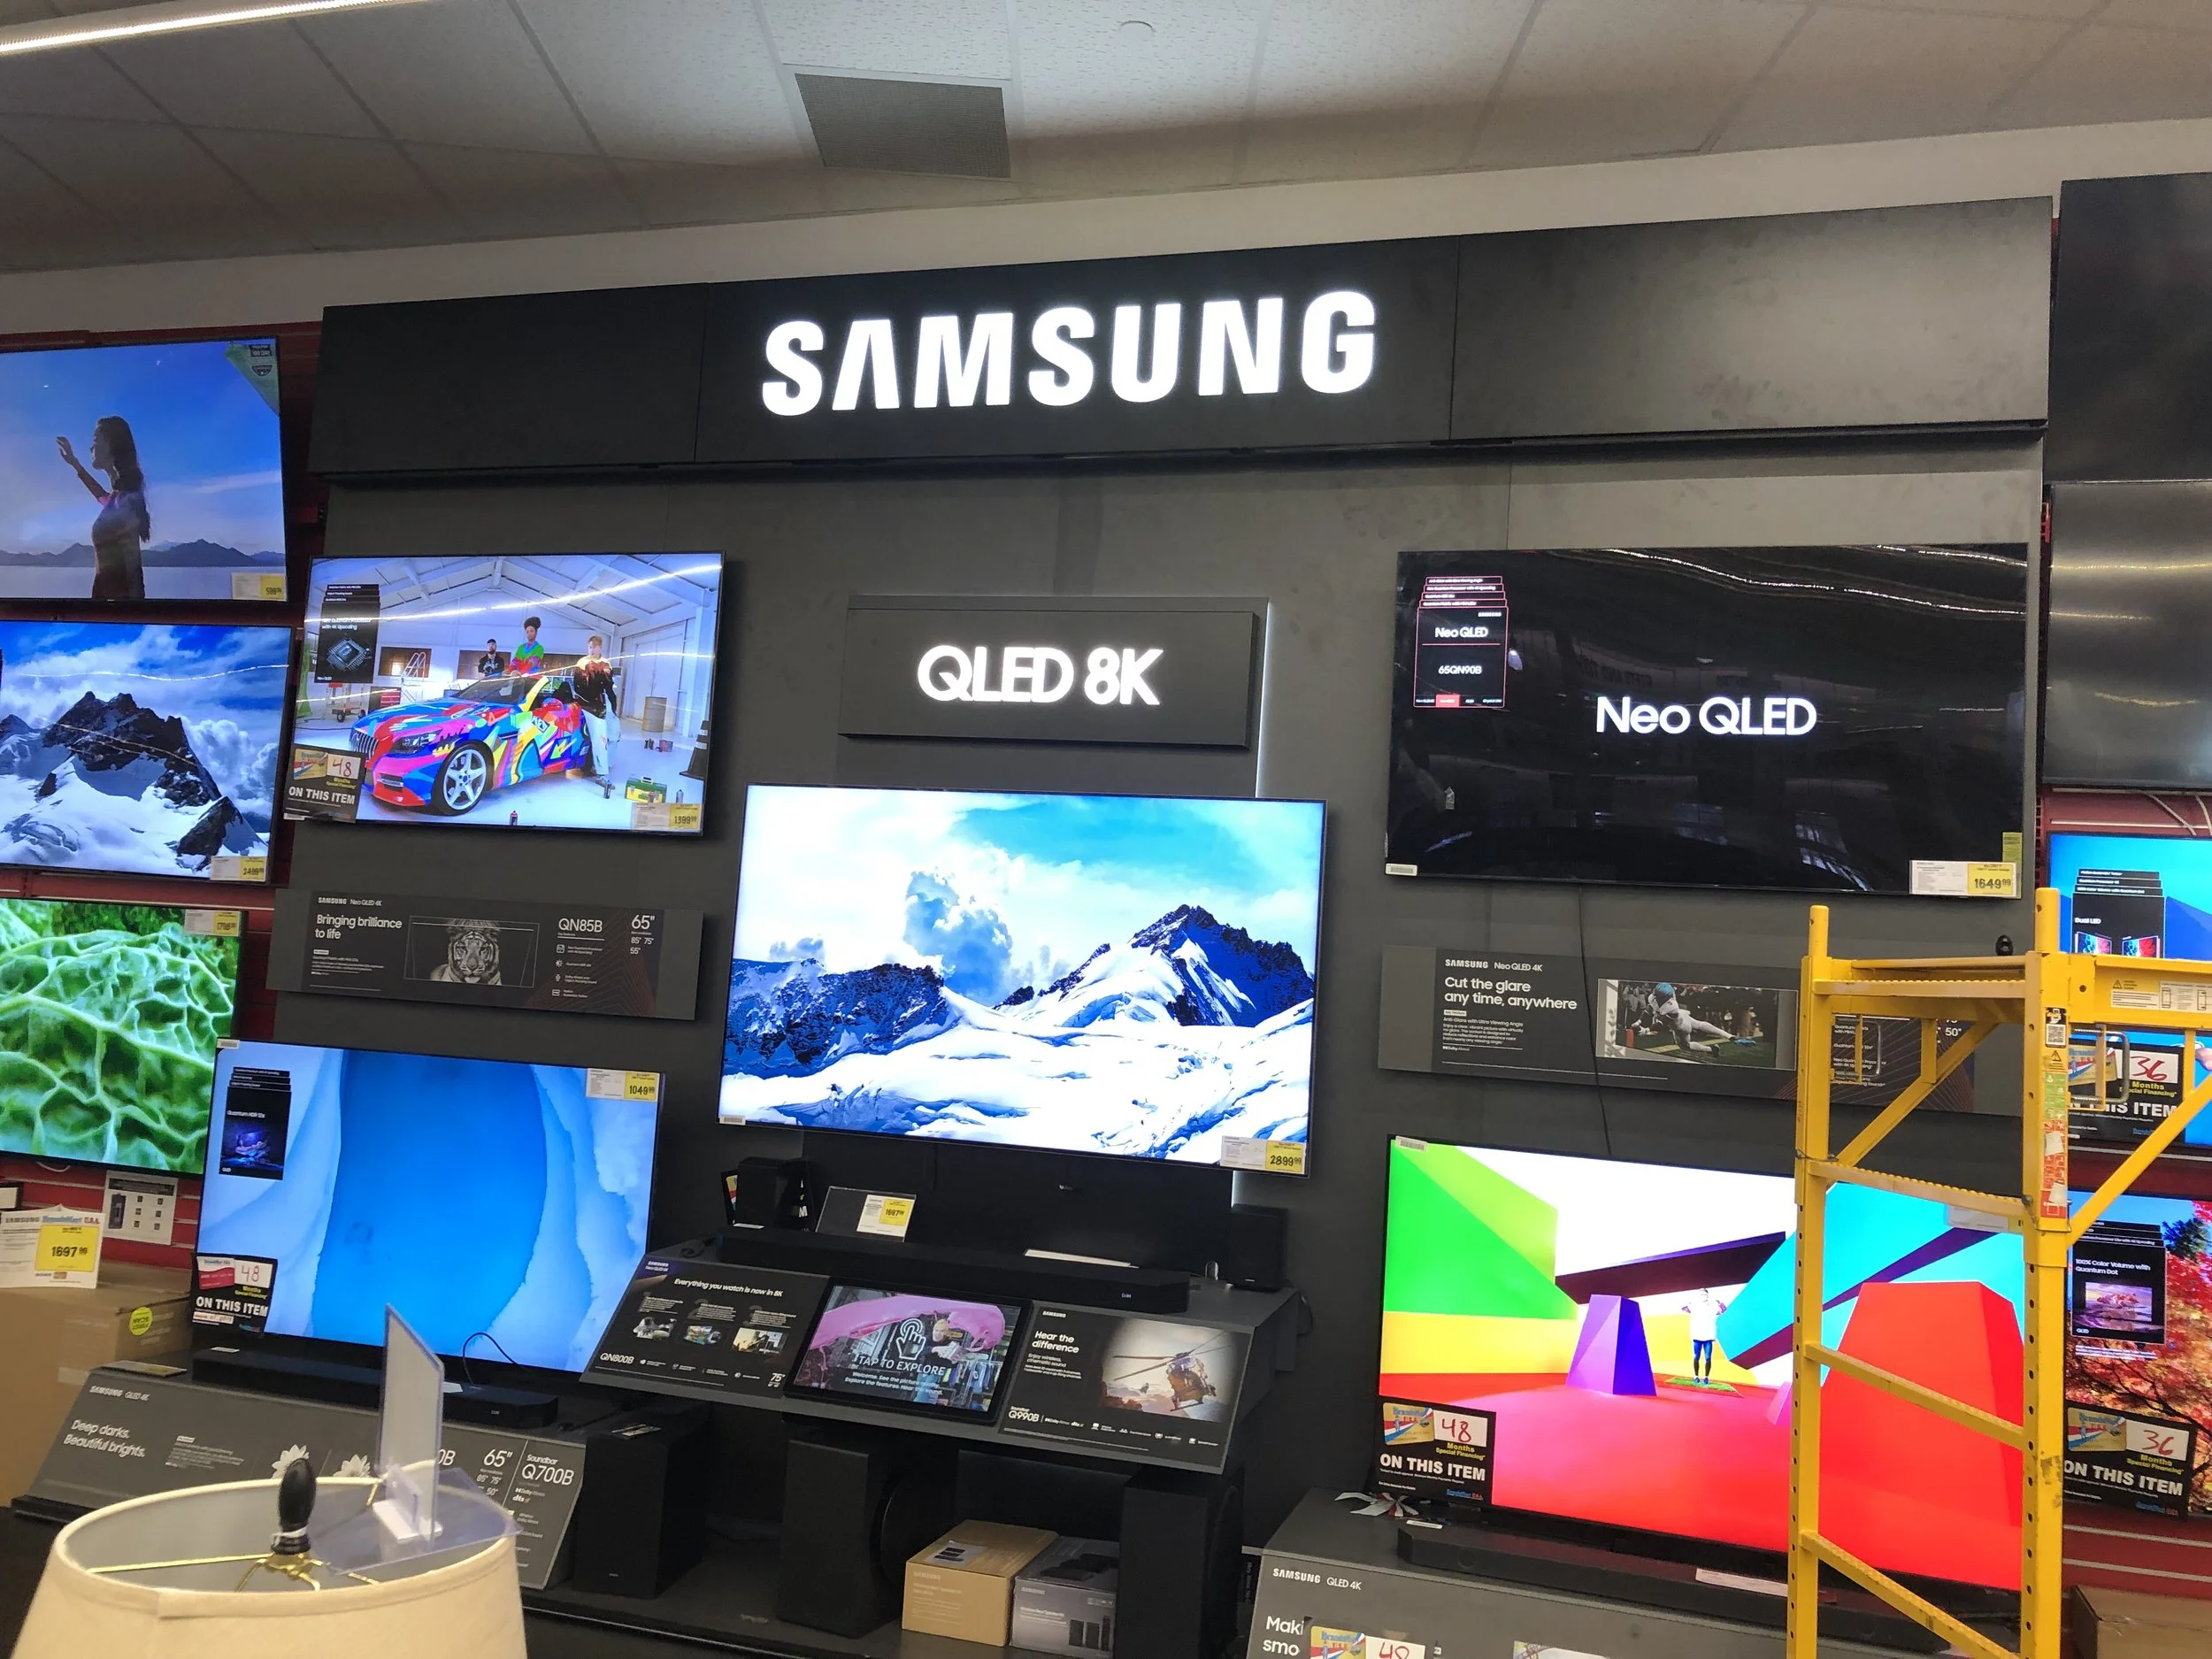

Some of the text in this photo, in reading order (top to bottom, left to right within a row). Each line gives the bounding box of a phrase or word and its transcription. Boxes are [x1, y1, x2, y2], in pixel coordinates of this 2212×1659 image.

[761, 290, 1377, 416] SAMSUNG
[1434, 626, 1488, 639] Neo QLED
[917, 644, 1164, 706] QLED 8K
[1438, 665, 1483, 674] 65QN90B
[1596, 695, 1817, 736] Neo QLED
[333, 757, 352, 777] 48
[288, 786, 356, 805] ON THIS ITEM
[1974, 878, 2001, 889] 1649
[317, 913, 403, 929] Bringing brilliance
[557, 918, 603, 933] QN85B
[632, 915, 655, 930] 65"
[315, 927, 342, 940] to life
[1444, 959, 1488, 969] SAMSUNG
[1494, 961, 1511, 970] Neo
[1511, 963, 1531, 972] QLED
[1444, 977, 1532, 995] Cut the glare
[1444, 992, 1578, 1010] any time, anywhere
[1945, 1026, 1962, 1037] 50"
[2131, 1055, 2168, 1081] 36
[629, 1085, 649, 1095] 1049
[2132, 1081, 2166, 1090] Months
[2133, 1102, 2178, 1117] ITEM
[1269, 1154, 1294, 1166] 2899
[51, 1246, 78, 1257] 1697
[241, 1265, 260, 1283] 48
[674, 1278, 710, 1290] Everything
[196, 1295, 269, 1317] ON THIS ITEM
[1034, 1331, 1075, 1343] Hear the
[1032, 1340, 1079, 1354] difference
[600, 1352, 635, 1364] QN800B
[858, 1356, 947, 1376] TAP TO EXPLORE
[88, 1386, 124, 1397] SAMSUNG
[1009, 1410, 1040, 1423] Q990B
[71, 1419, 131, 1439] Deep darks.
[1440, 1417, 1472, 1442] 48
[63, 1433, 108, 1451] Beautiful
[107, 1440, 147, 1458] brights.
[1446, 1442, 1476, 1453] Months
[2141, 1430, 2175, 1455] 36
[483, 1448, 513, 1468] 65"
[526, 1453, 559, 1465] Soundbar
[1435, 1448, 1456, 1456] Special
[1380, 1453, 1486, 1481] ON THIS ITEM
[2141, 1454, 2173, 1467] Months
[520, 1463, 575, 1486] Q700B
[2063, 1460, 2088, 1478] ON
[2092, 1465, 2134, 1486] THIS
[2139, 1475, 2184, 1497] ITEM
[1272, 1568, 1363, 1591] SAMSUNG QLED 4K
[1265, 1616, 1304, 1635] Maki
[1262, 1639, 1301, 1656] smo
[1379, 1640, 1410, 1659] 48
